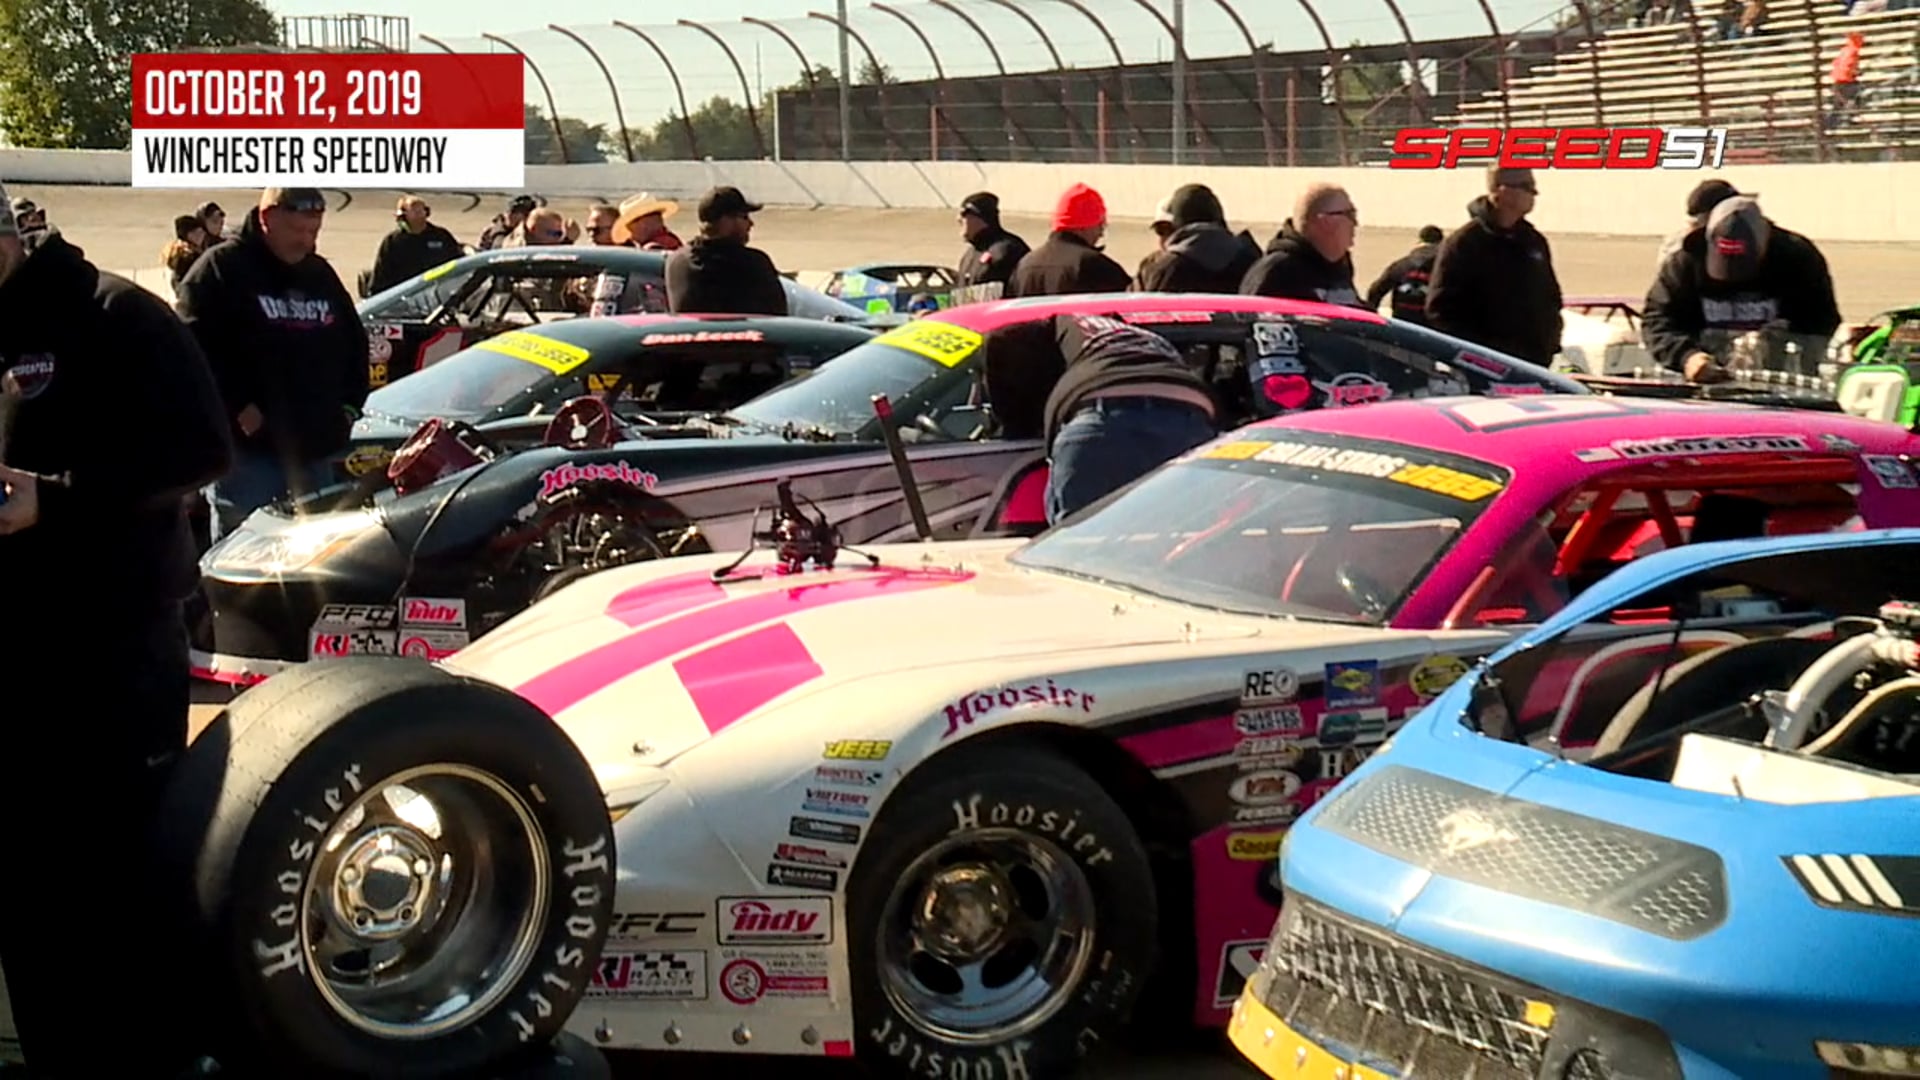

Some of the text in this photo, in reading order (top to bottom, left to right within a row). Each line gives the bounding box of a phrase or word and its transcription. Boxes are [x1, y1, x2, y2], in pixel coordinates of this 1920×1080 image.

[539, 461, 659, 495] Hoosier
[941, 679, 1097, 740] Hoosier
[824, 740, 892, 760] JEGS
[953, 792, 1114, 866] Hoosier
[255, 763, 363, 978] Hoosier
[509, 833, 610, 1041] Hoosier
[731, 901, 819, 932] indy
